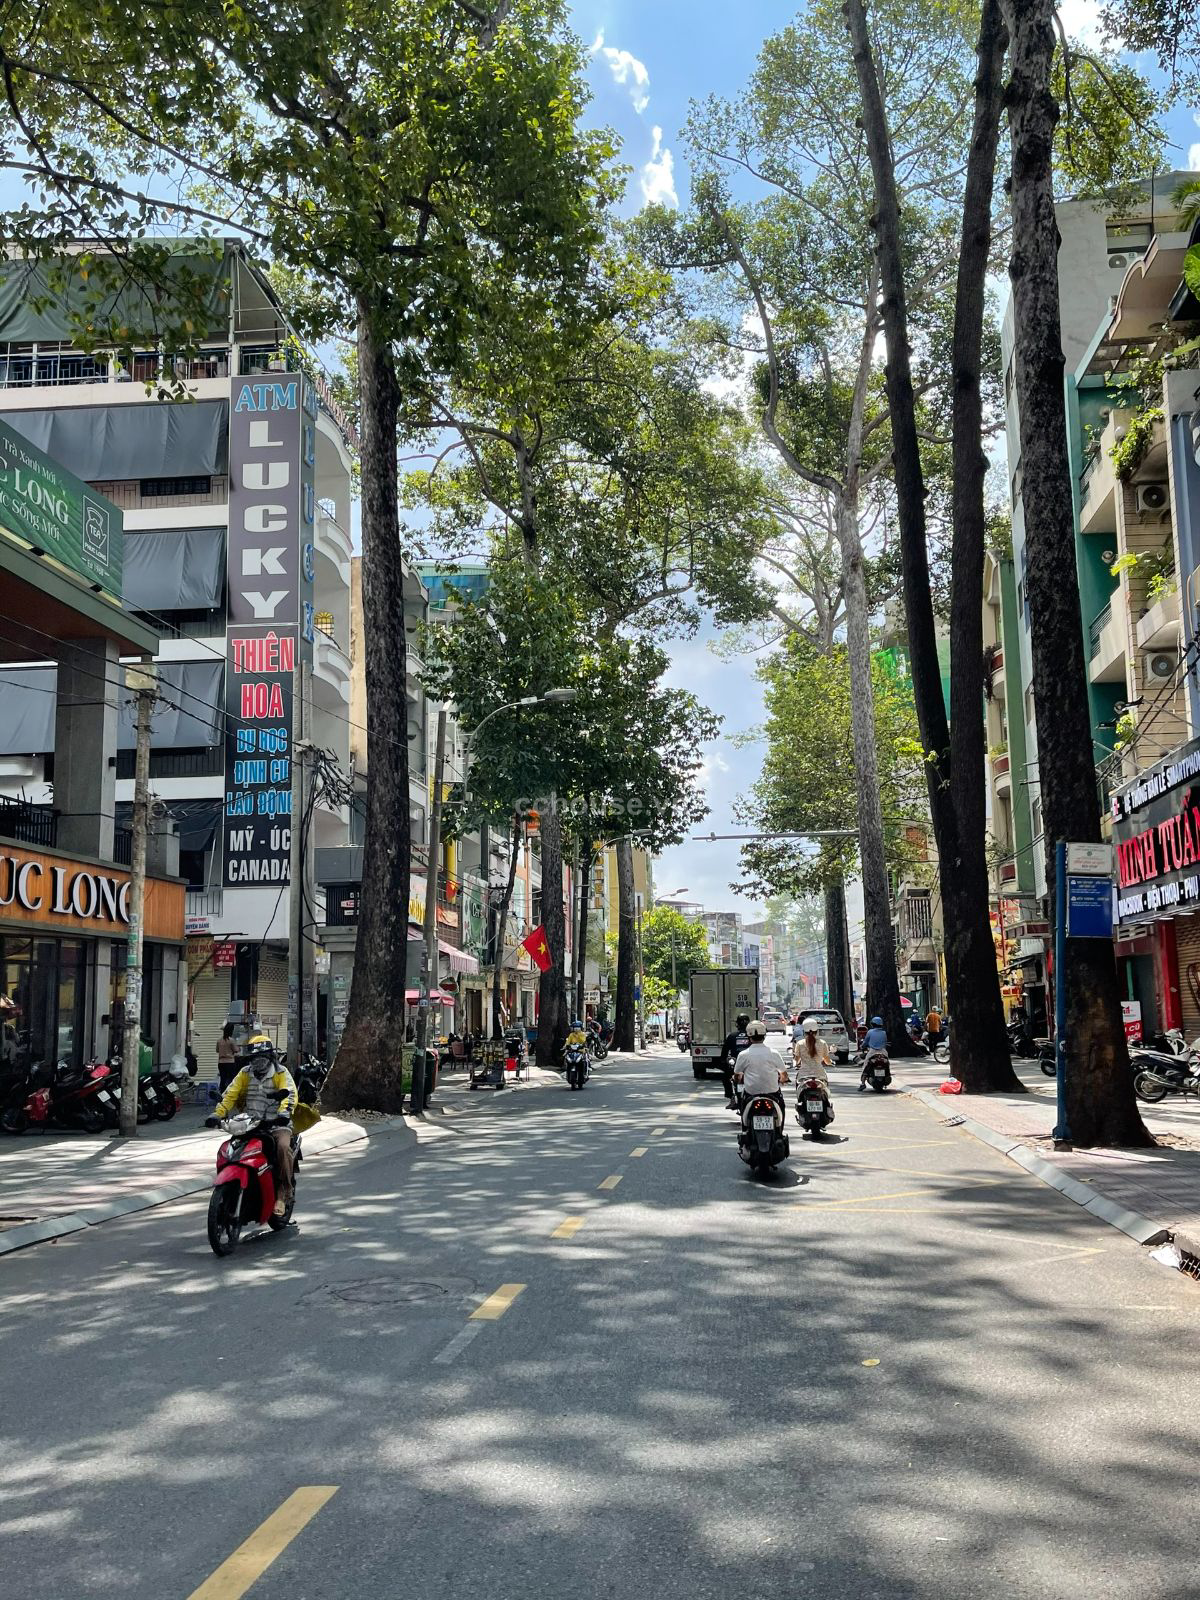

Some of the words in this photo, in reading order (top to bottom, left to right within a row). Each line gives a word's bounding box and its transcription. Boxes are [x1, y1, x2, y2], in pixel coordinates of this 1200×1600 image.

[235, 383, 298, 412] ATM
[3, 437, 17, 458] Trà
[19, 449, 41, 475] Xanh
[14, 467, 69, 525] LONG
[12, 498, 40, 531] Sống
[241, 421, 290, 619] LUCKY
[89, 524, 101, 540] TEA
[231, 631, 294, 673] THIÊN
[241, 682, 284, 718] HOA
[237, 729, 256, 753] DU
[259, 728, 287, 756] HỌC
[234, 760, 267, 788] ĐỊNH
[227, 792, 253, 816] LAO
[229, 825, 254, 851] MỸ
[270, 824, 291, 851] ÚC
[228, 858, 291, 882] CANADA
[1116, 827, 1158, 889] MINH
